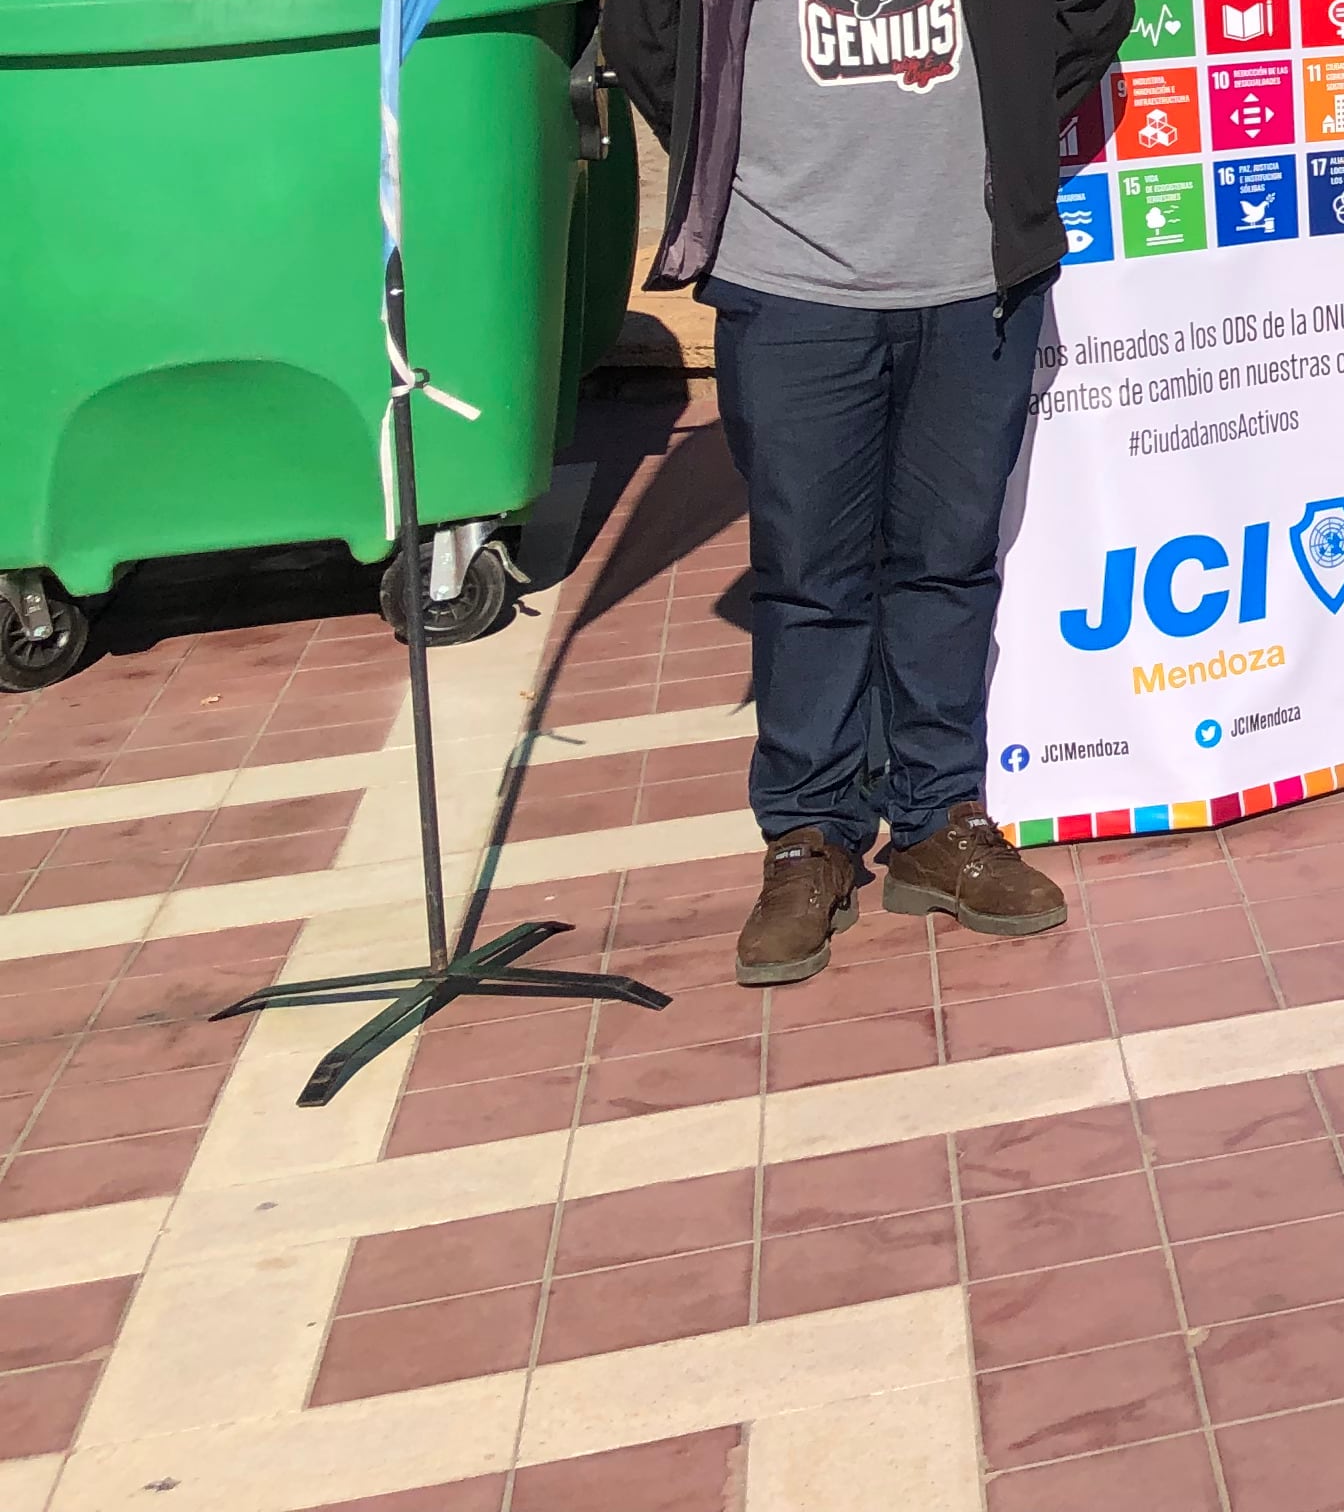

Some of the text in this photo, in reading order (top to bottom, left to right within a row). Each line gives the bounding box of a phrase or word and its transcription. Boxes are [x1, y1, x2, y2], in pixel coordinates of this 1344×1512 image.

[1211, 70, 1230, 90] 10
[1306, 64, 1322, 82] 11
[1117, 79, 1127, 98] 9
[1217, 167, 1236, 186] 16
[1310, 158, 1328, 177] 17
[1123, 176, 1141, 195] 15
[1330, 176, 1343, 185] LOS
[1075, 329, 1169, 366] alineados
[1174, 330, 1186, 353] a
[1189, 322, 1217, 351] los
[1222, 314, 1258, 346] ODS
[1262, 310, 1285, 340] de
[1290, 307, 1308, 337] la
[1028, 383, 1113, 421] agentes
[1118, 377, 1143, 407] de
[1148, 367, 1213, 404] cambio
[1218, 364, 1241, 392] en
[1246, 353, 1331, 387] nuestras
[1129, 410, 1300, 457] #CiudadanosActivos
[1059, 521, 1271, 652] JCI
[1132, 644, 1287, 696] Mendoza
[1230, 702, 1302, 739] JCIMendoza
[1040, 736, 1130, 765] JCIMendoza
